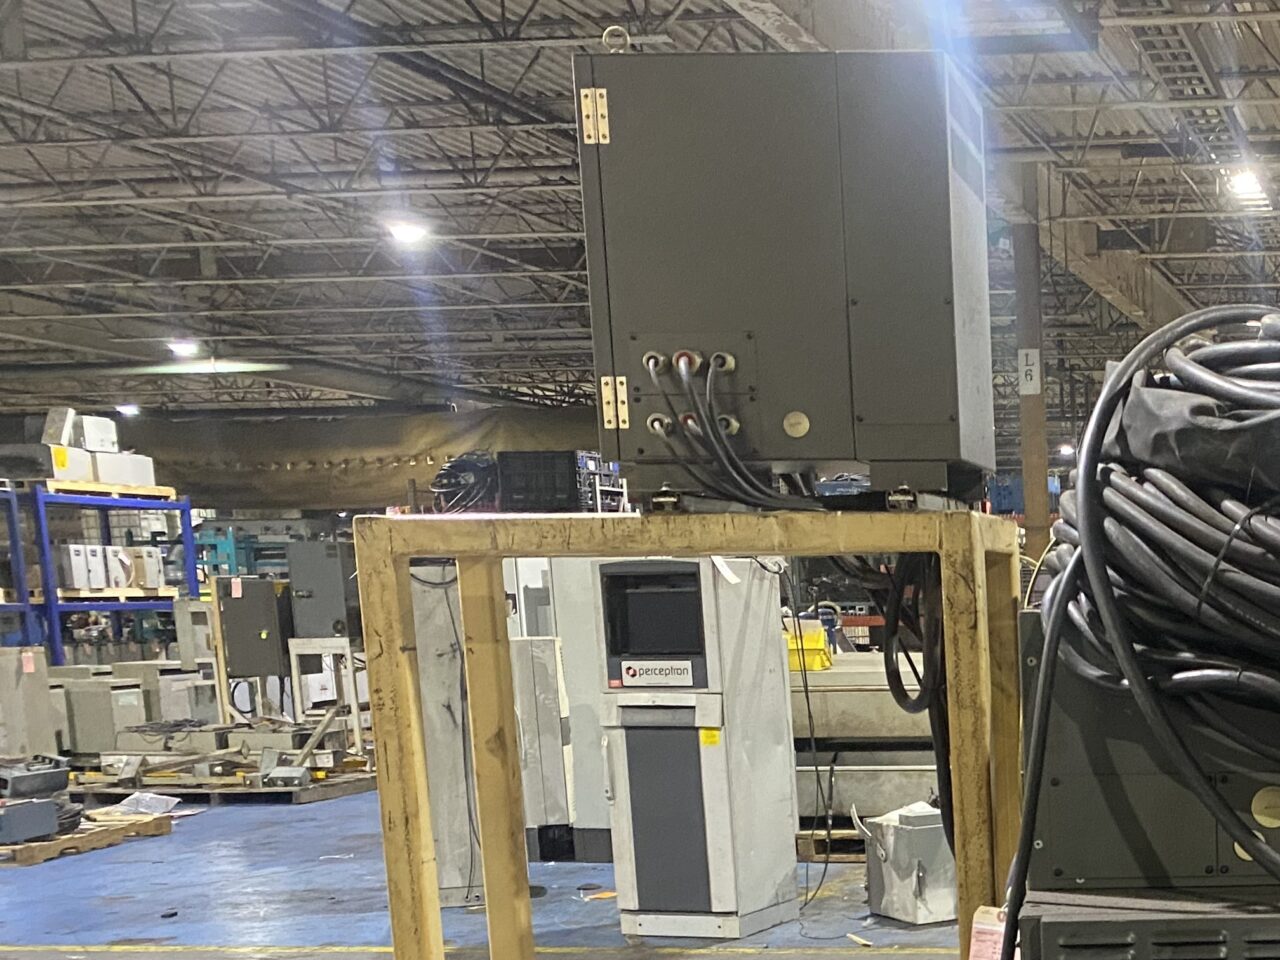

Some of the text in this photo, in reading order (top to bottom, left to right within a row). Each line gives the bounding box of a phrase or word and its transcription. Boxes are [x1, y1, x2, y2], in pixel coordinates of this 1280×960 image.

[1024, 352, 1035, 367] L
[1024, 368, 1033, 382] 6
[638, 665, 689, 678] perceptron
